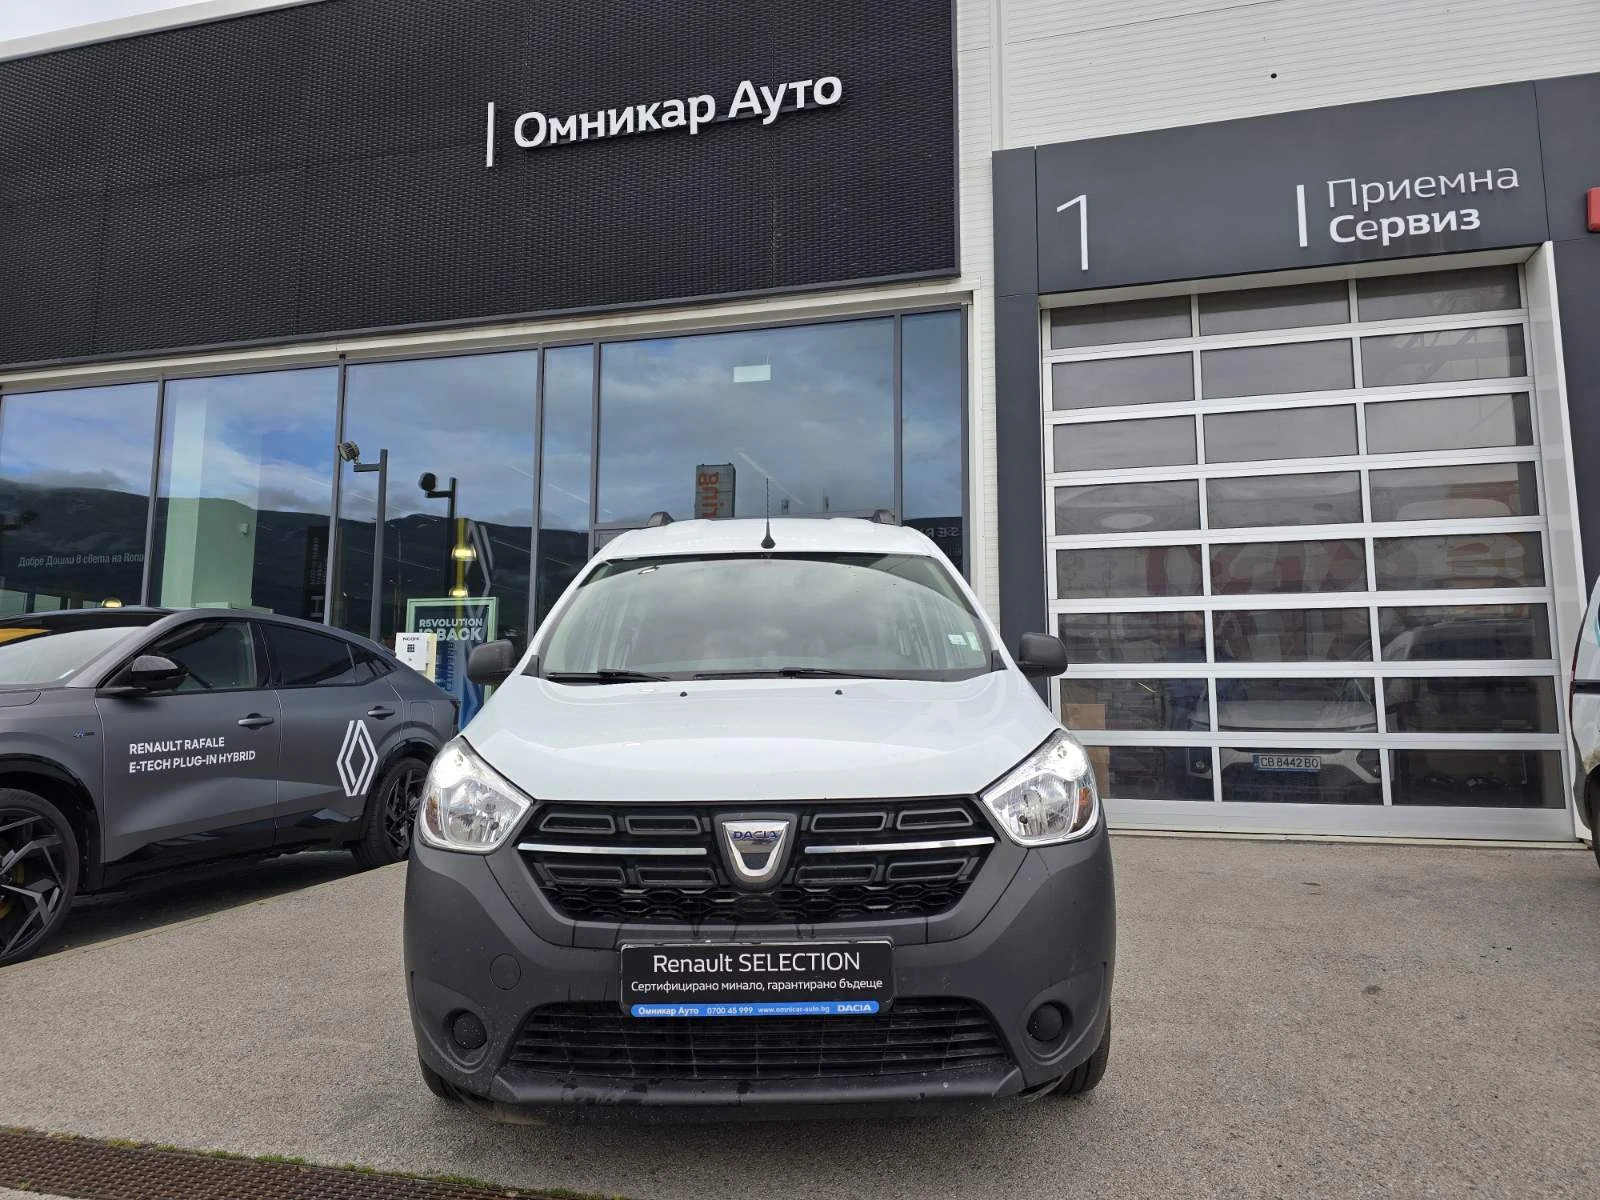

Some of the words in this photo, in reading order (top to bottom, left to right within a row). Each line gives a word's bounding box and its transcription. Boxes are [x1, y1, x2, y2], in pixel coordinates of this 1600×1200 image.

[513, 93, 716, 148] Омникар
[728, 76, 843, 126] Ауто
[1326, 167, 1520, 212] Приемна
[1056, 194, 1089, 271] 1
[1329, 208, 1481, 246] Сервиз
[18, 556, 44, 568] Добре
[437, 627, 482, 641] BACK
[129, 740, 182, 755] RENAULT
[184, 737, 225, 750] RAFALE
[129, 759, 171, 773] E-TECH
[173, 754, 217, 769] PLUG-IN
[218, 750, 256, 764] HYBRID
[1276, 757, 1303, 768] 8442
[733, 830, 778, 840] DACIA
[653, 953, 733, 973] Renault
[738, 952, 860, 973] SELECTION
[631, 980, 719, 993] Сертифицирано
[721, 981, 765, 992] минало,
[767, 980, 837, 992] гарантирано
[839, 977, 883, 990] бъдеще
[638, 1007, 677, 1016] Омникар
[678, 1006, 699, 1016] Ауто
[707, 1007, 726, 1015] 0700
[739, 1006, 754, 1014] 999
[837, 1004, 872, 1012] DACIA
